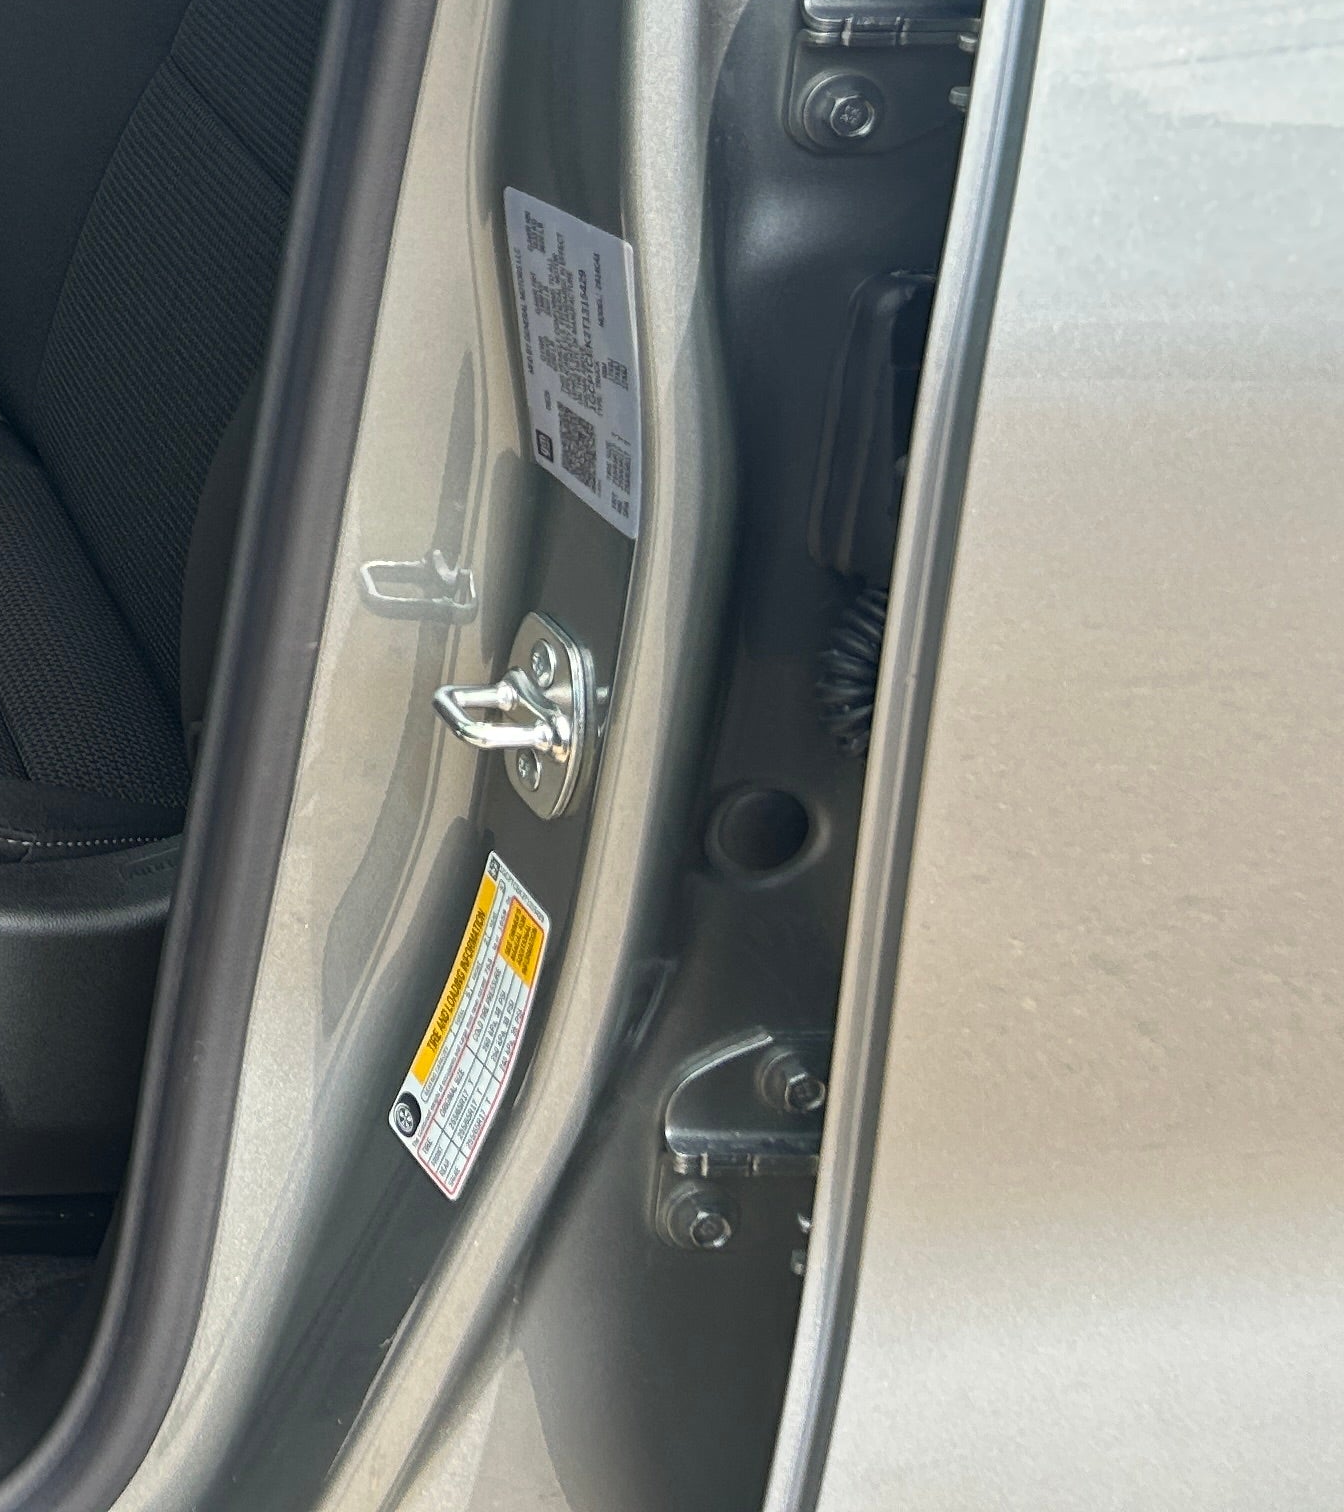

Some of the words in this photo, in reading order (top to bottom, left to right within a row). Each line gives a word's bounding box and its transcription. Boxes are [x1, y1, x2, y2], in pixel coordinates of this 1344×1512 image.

[426, 1026, 441, 1055] TIRE
[436, 1006, 450, 1034] AND
[444, 966, 466, 1014] LOADING
[458, 906, 487, 973] INFORMATION
[438, 1080, 457, 1120] ORIGINAL
[453, 1065, 464, 1087] SIZE
[470, 1017, 484, 1044] COLD
[483, 965, 502, 1007] PRESSURE
